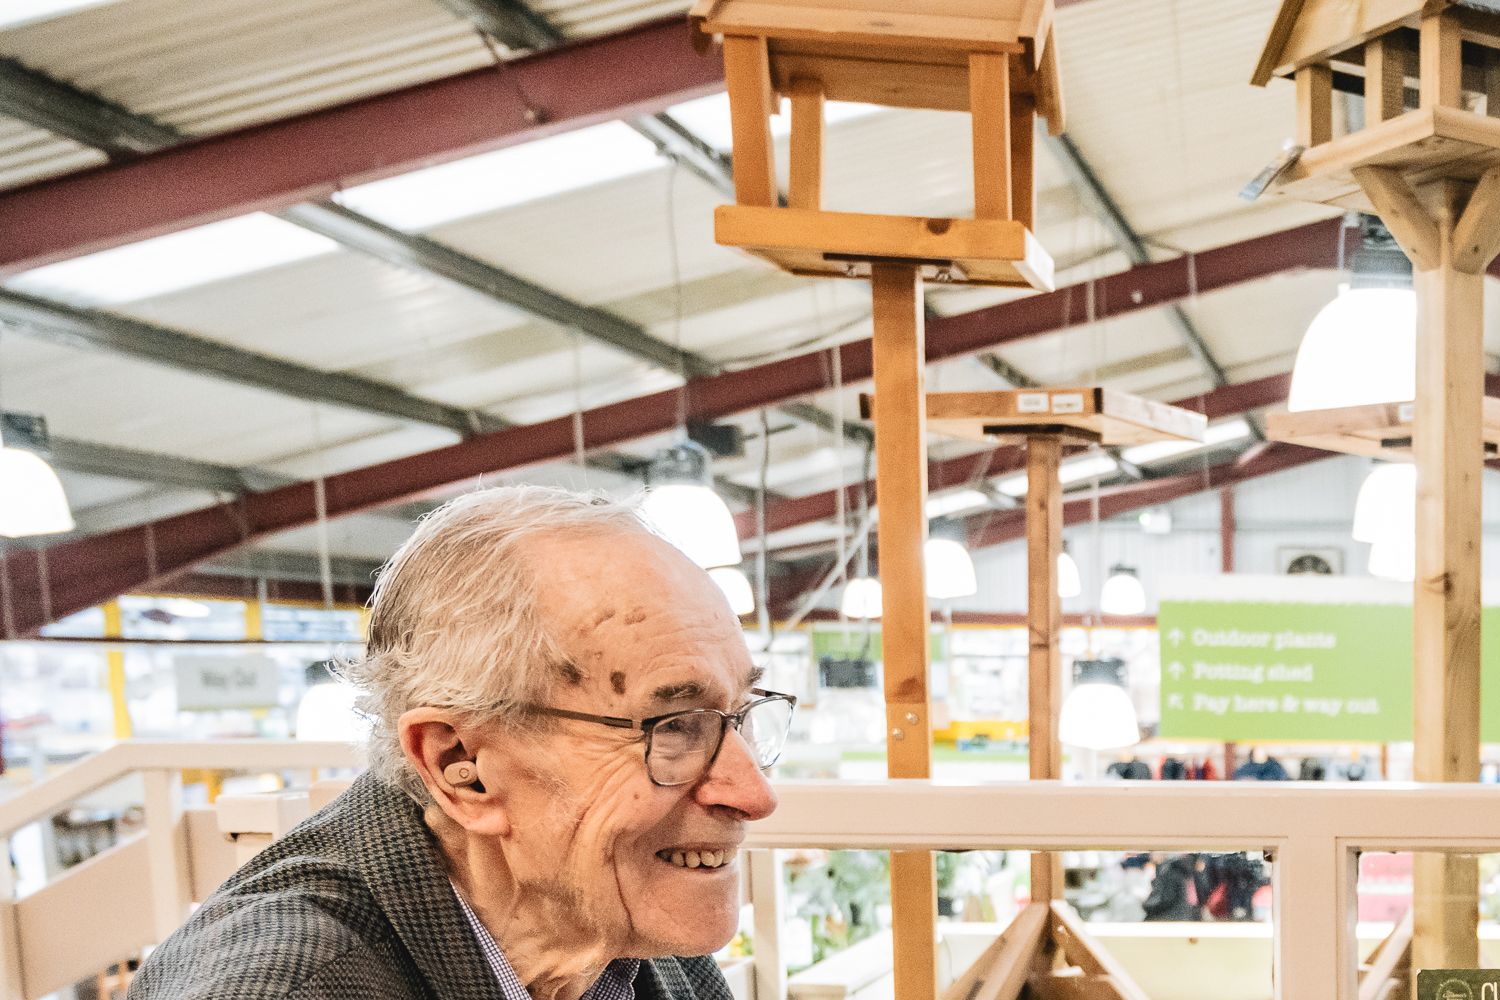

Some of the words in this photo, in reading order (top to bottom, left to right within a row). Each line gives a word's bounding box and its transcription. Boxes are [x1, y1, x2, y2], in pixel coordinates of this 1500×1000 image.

[1192, 628, 1271, 647] Outdoor
[1274, 630, 1336, 651] plants
[1193, 661, 1264, 684] Potting
[1267, 662, 1313, 682] shed
[1193, 692, 1231, 715] Pay
[1233, 693, 1279, 713] here
[1282, 692, 1299, 713] &
[1303, 697, 1343, 717] way
[1345, 697, 1379, 714] out
